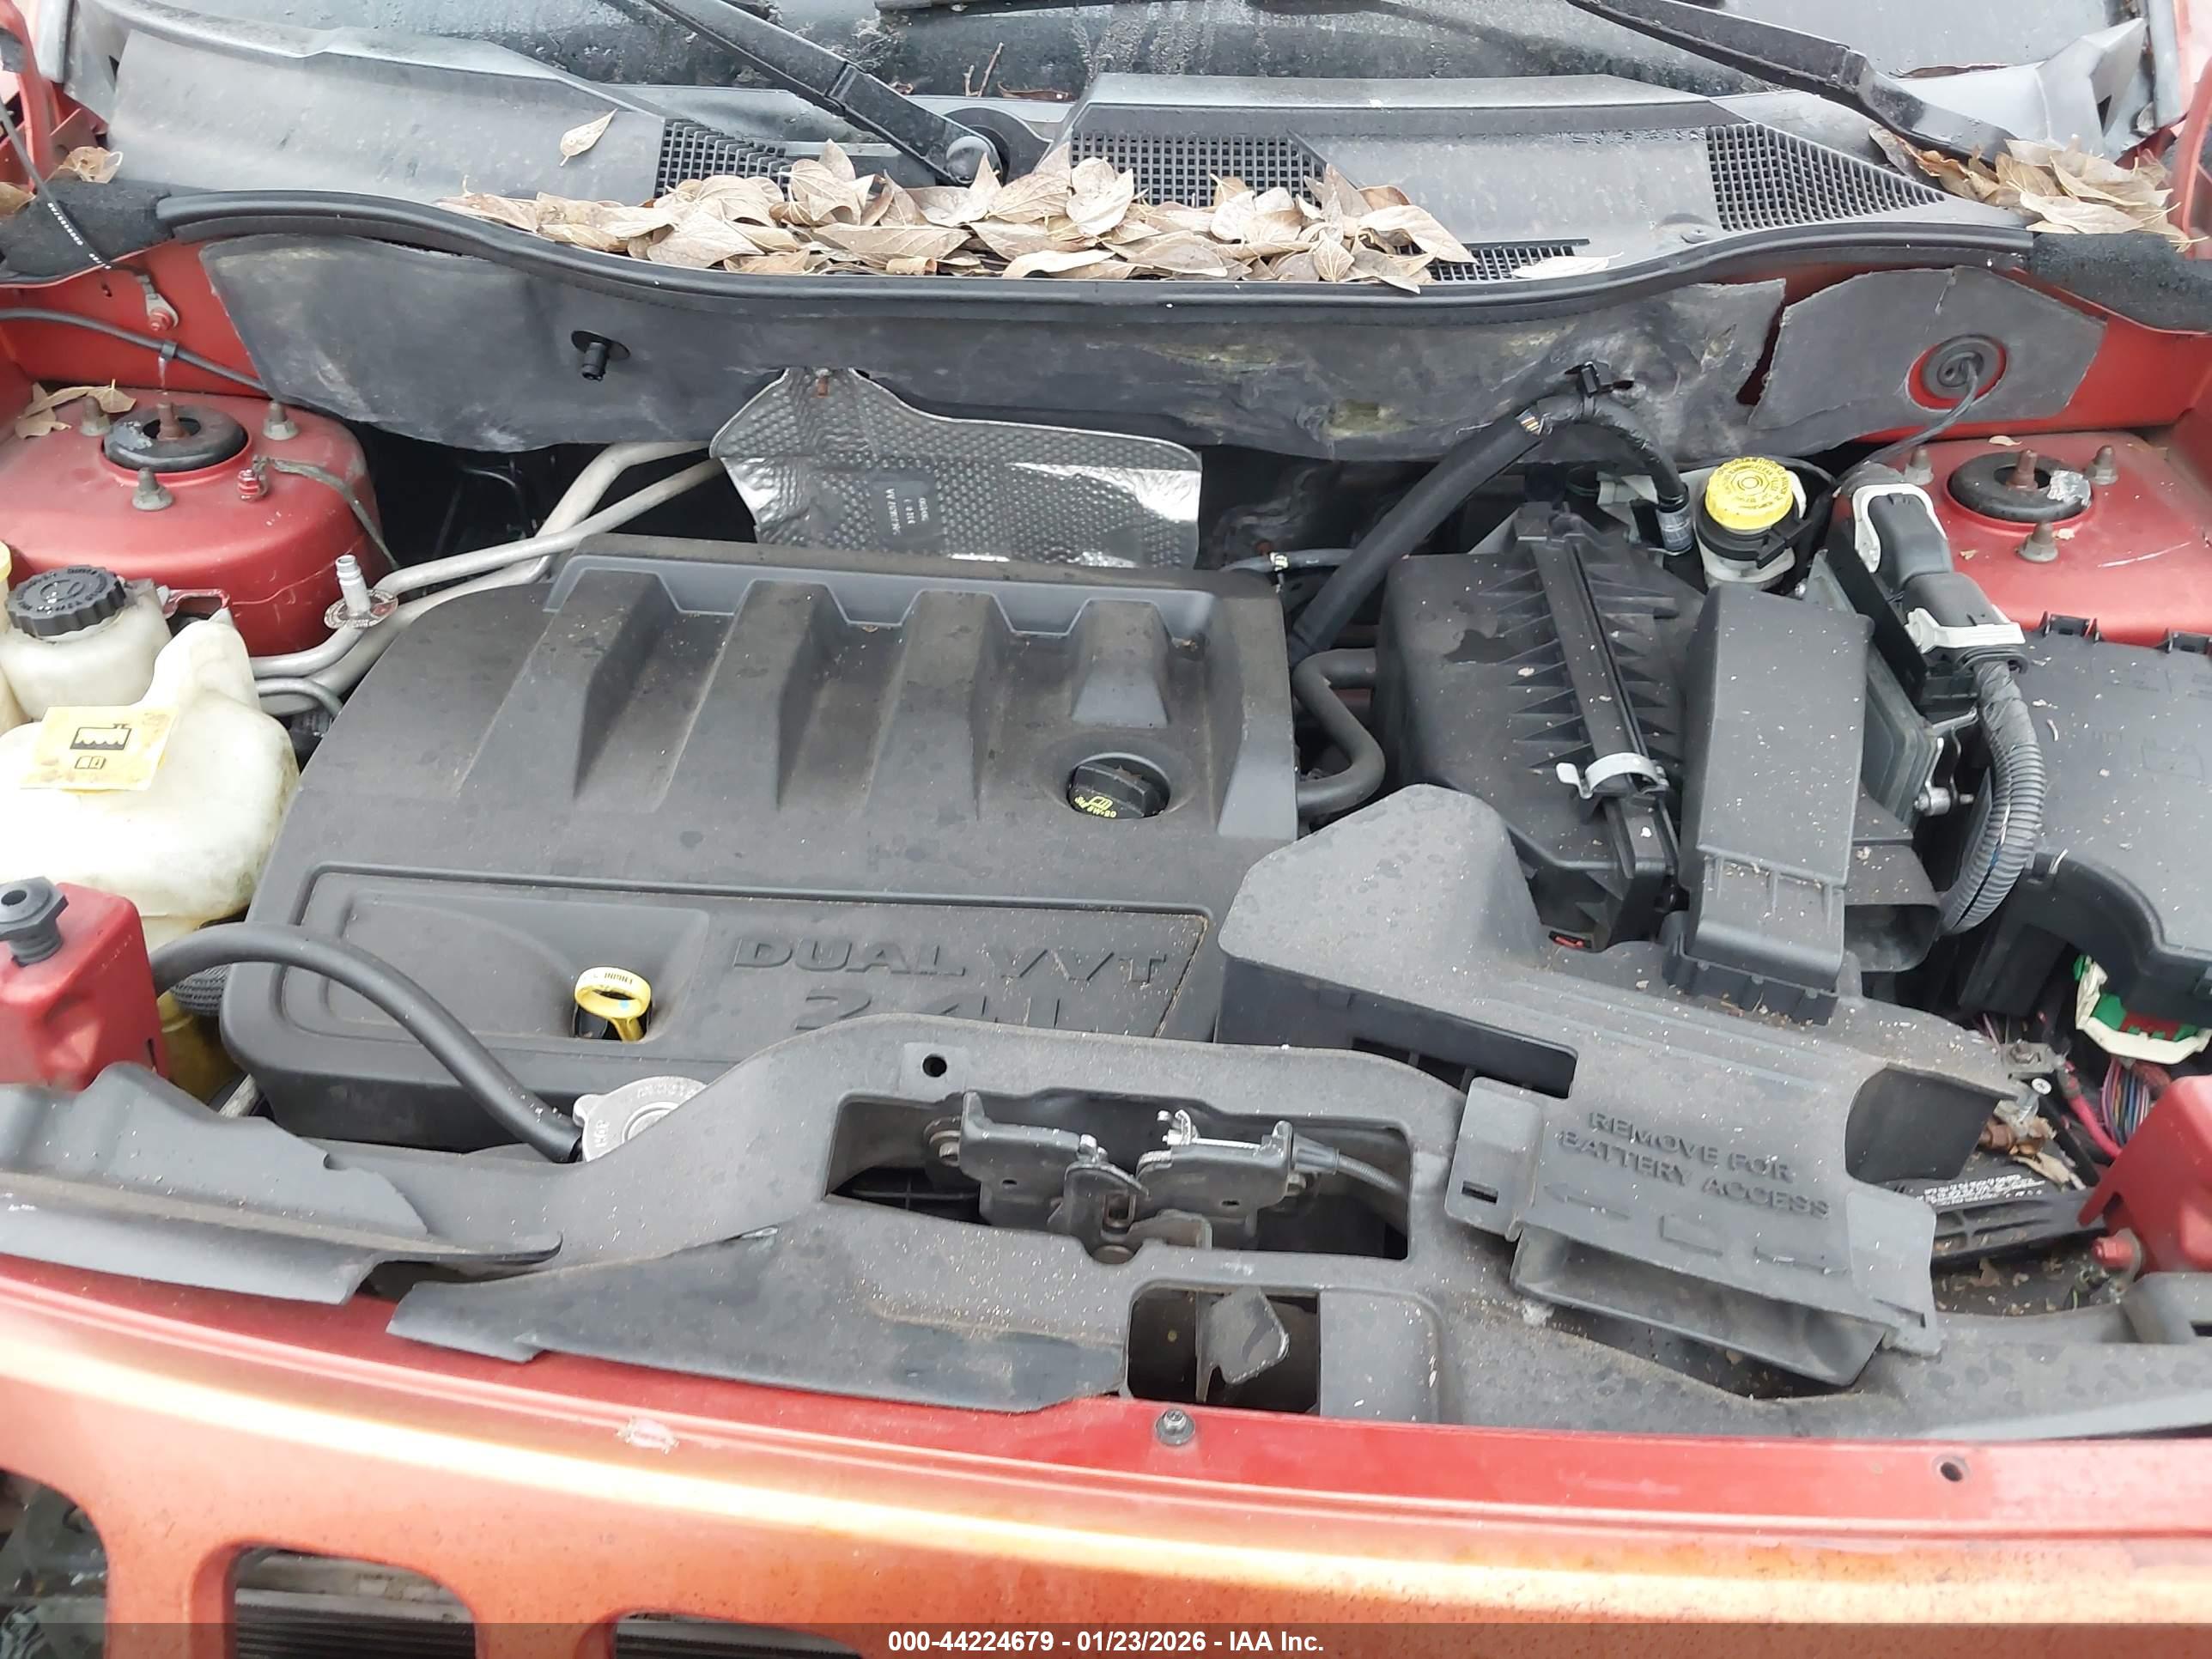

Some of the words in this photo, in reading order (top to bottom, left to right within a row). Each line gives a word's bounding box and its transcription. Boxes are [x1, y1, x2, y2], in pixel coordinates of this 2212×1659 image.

[733, 937, 966, 977] DUAL
[980, 946, 1167, 985] VVT
[1558, 1130, 1692, 1187] BATTERY
[1701, 1176, 1830, 1220] ACCESS
[1589, 1111, 1718, 1164] REMOVE
[1728, 1151, 1795, 1184] FOR
